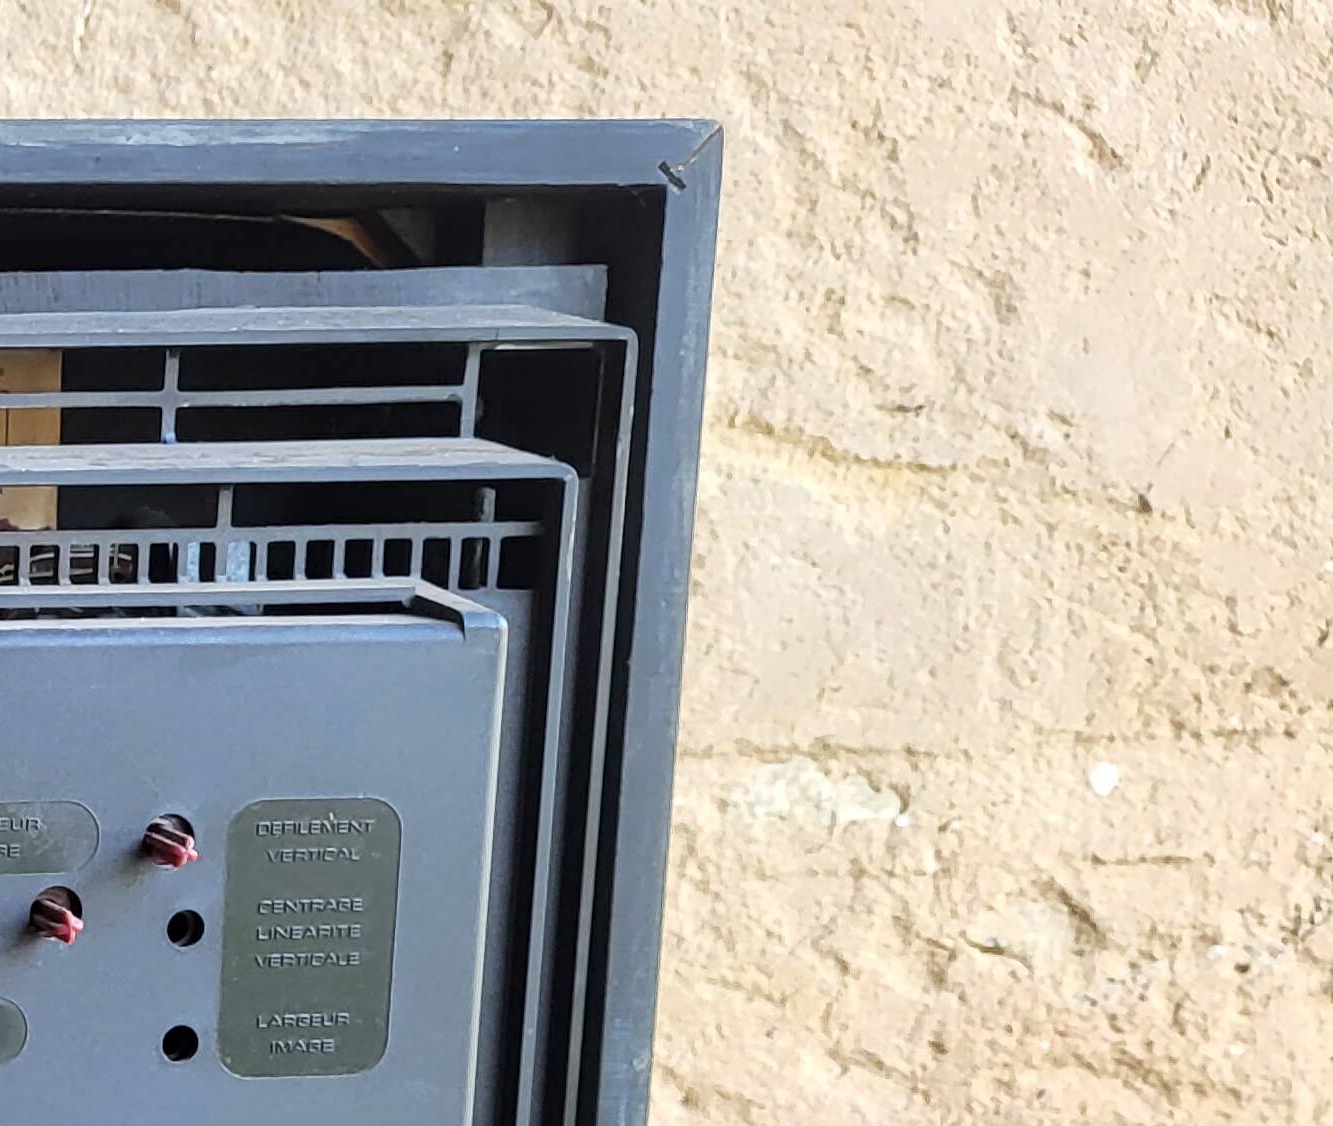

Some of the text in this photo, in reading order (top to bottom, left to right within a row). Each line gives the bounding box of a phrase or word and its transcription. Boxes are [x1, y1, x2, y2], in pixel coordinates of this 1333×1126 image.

[256, 819, 376, 836] DEFILEMENT
[266, 847, 361, 863] VERTICAL
[258, 898, 365, 914] CENTRAGE
[256, 924, 362, 941] LINEARITE
[254, 952, 361, 968] VERTICALE
[256, 1012, 350, 1029] LARGEUR
[270, 1039, 335, 1055] IMAGE
